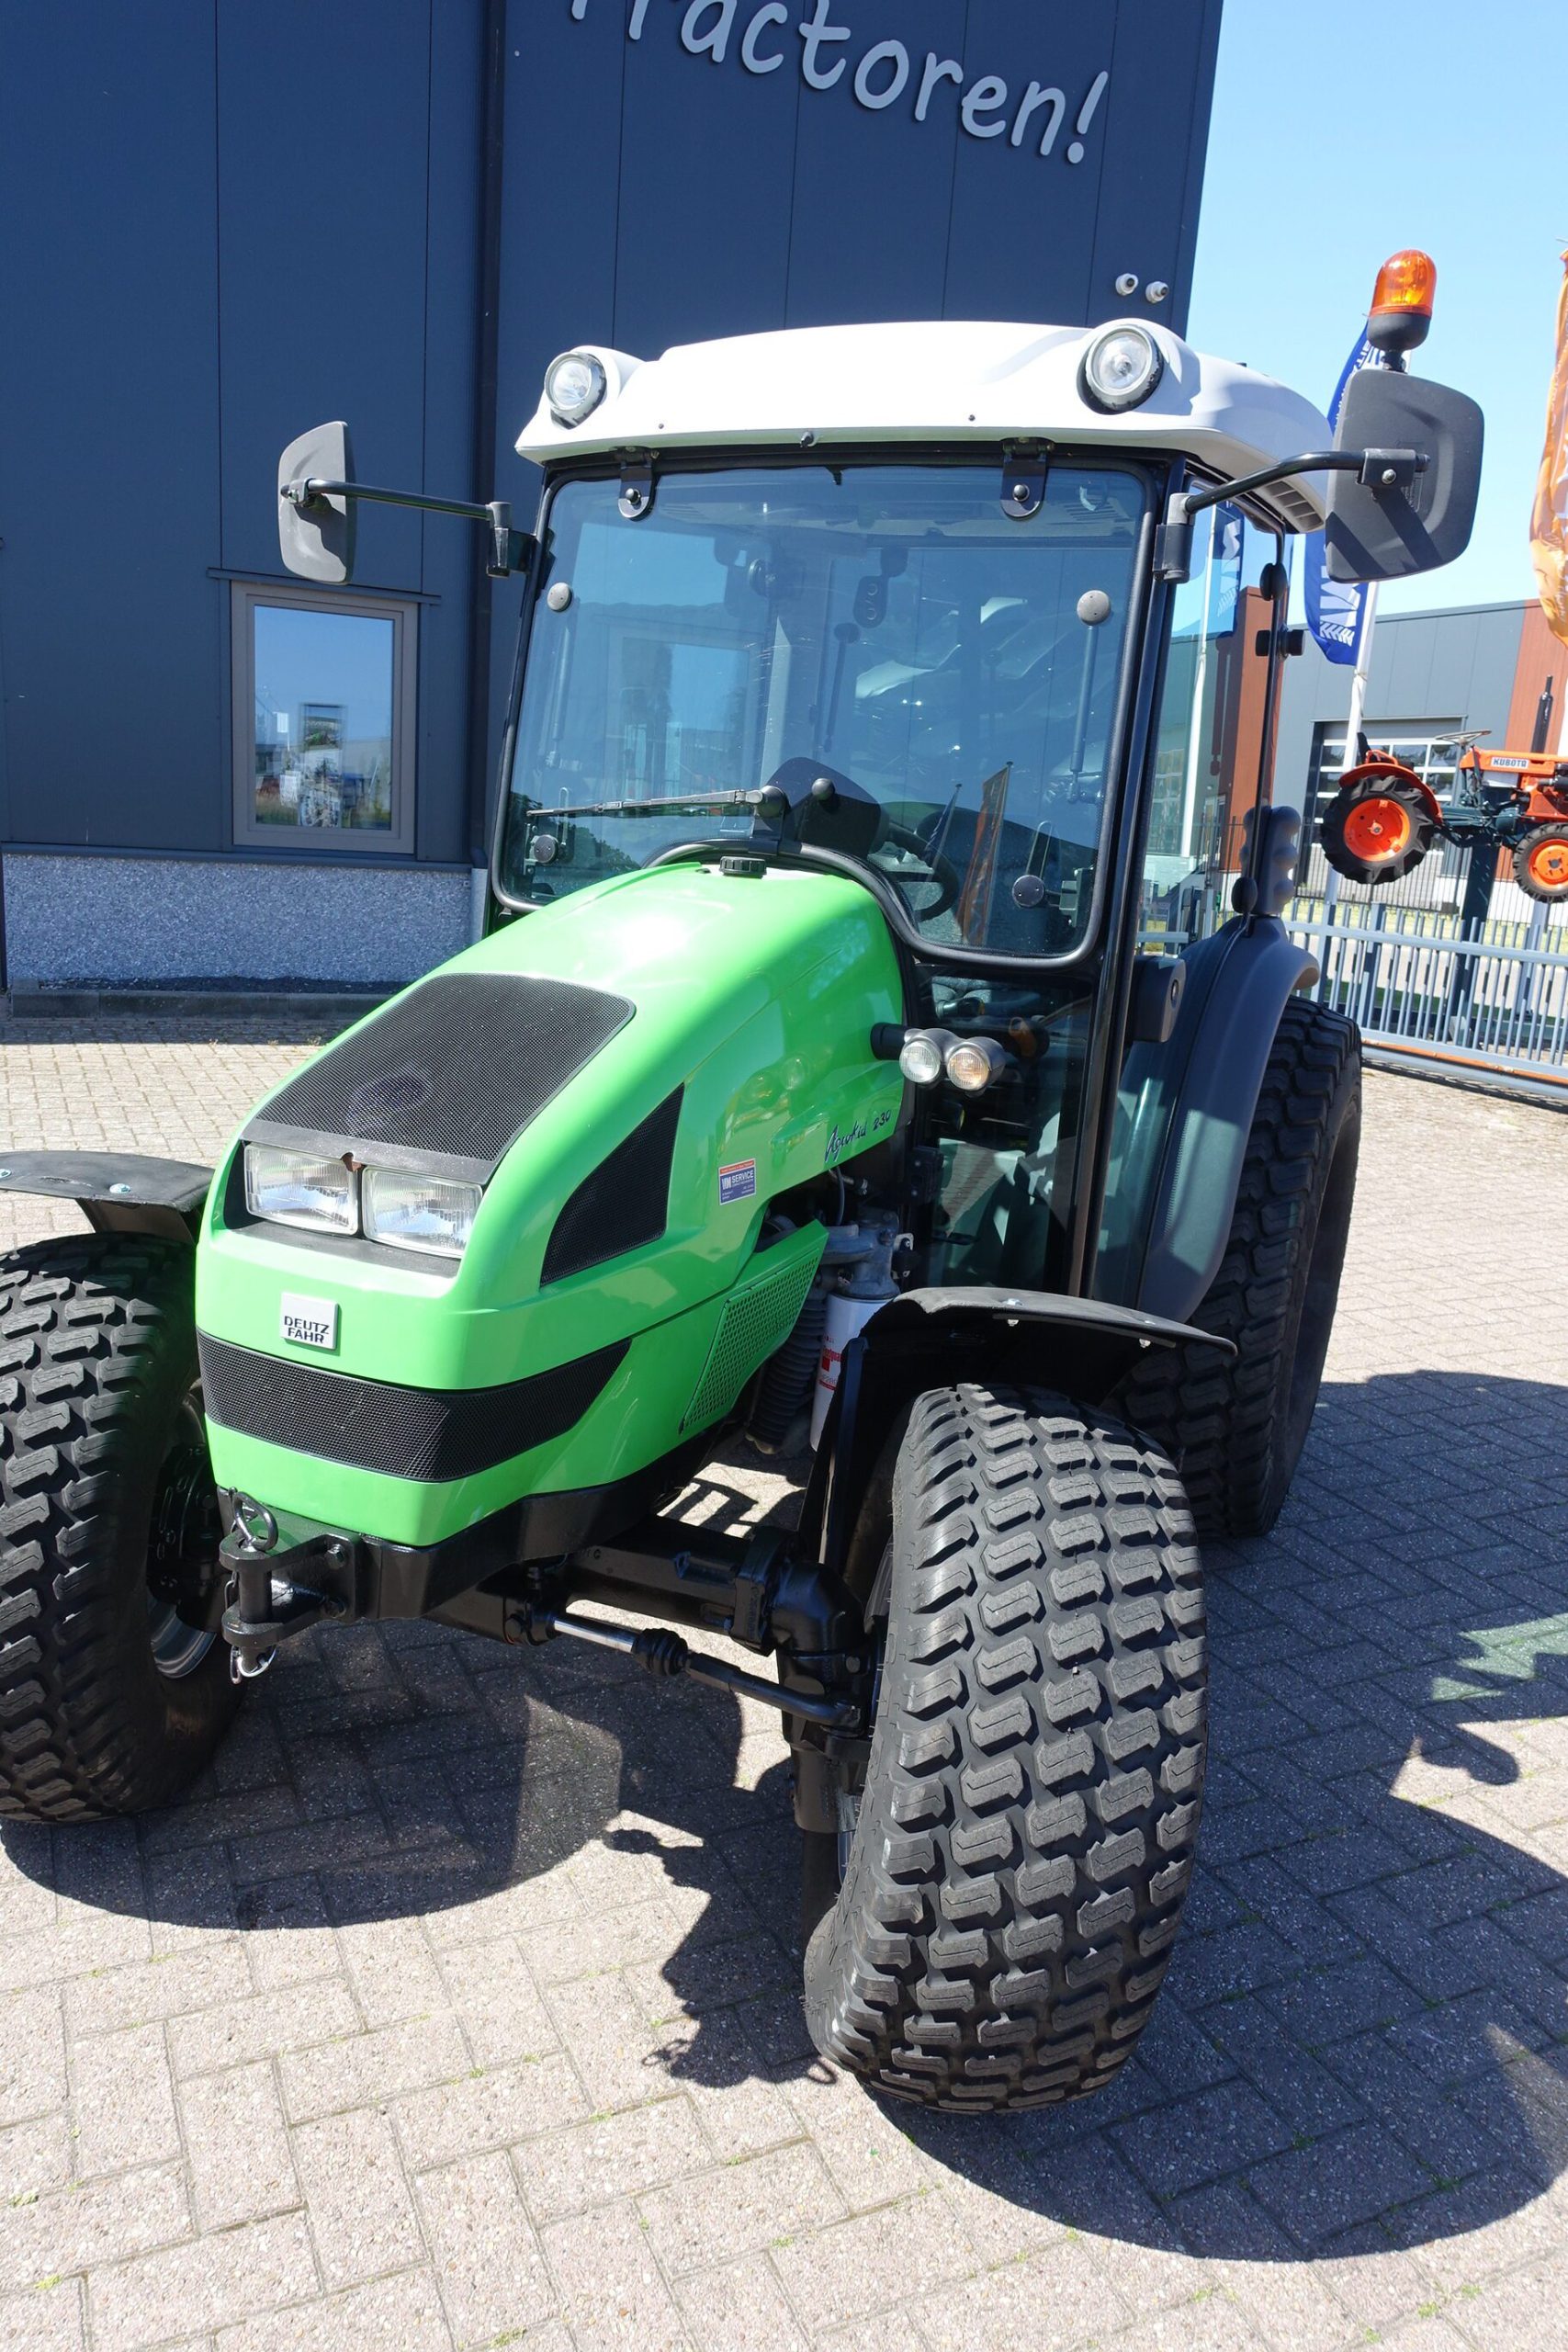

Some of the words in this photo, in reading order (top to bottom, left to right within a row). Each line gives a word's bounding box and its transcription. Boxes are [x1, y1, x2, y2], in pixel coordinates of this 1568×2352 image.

[1493, 758, 1528, 768] KUBOTA
[731, 1170, 754, 1184] SERVICE
[284, 1316, 330, 1335] DEUTZ
[288, 1327, 324, 1343] FAHR
